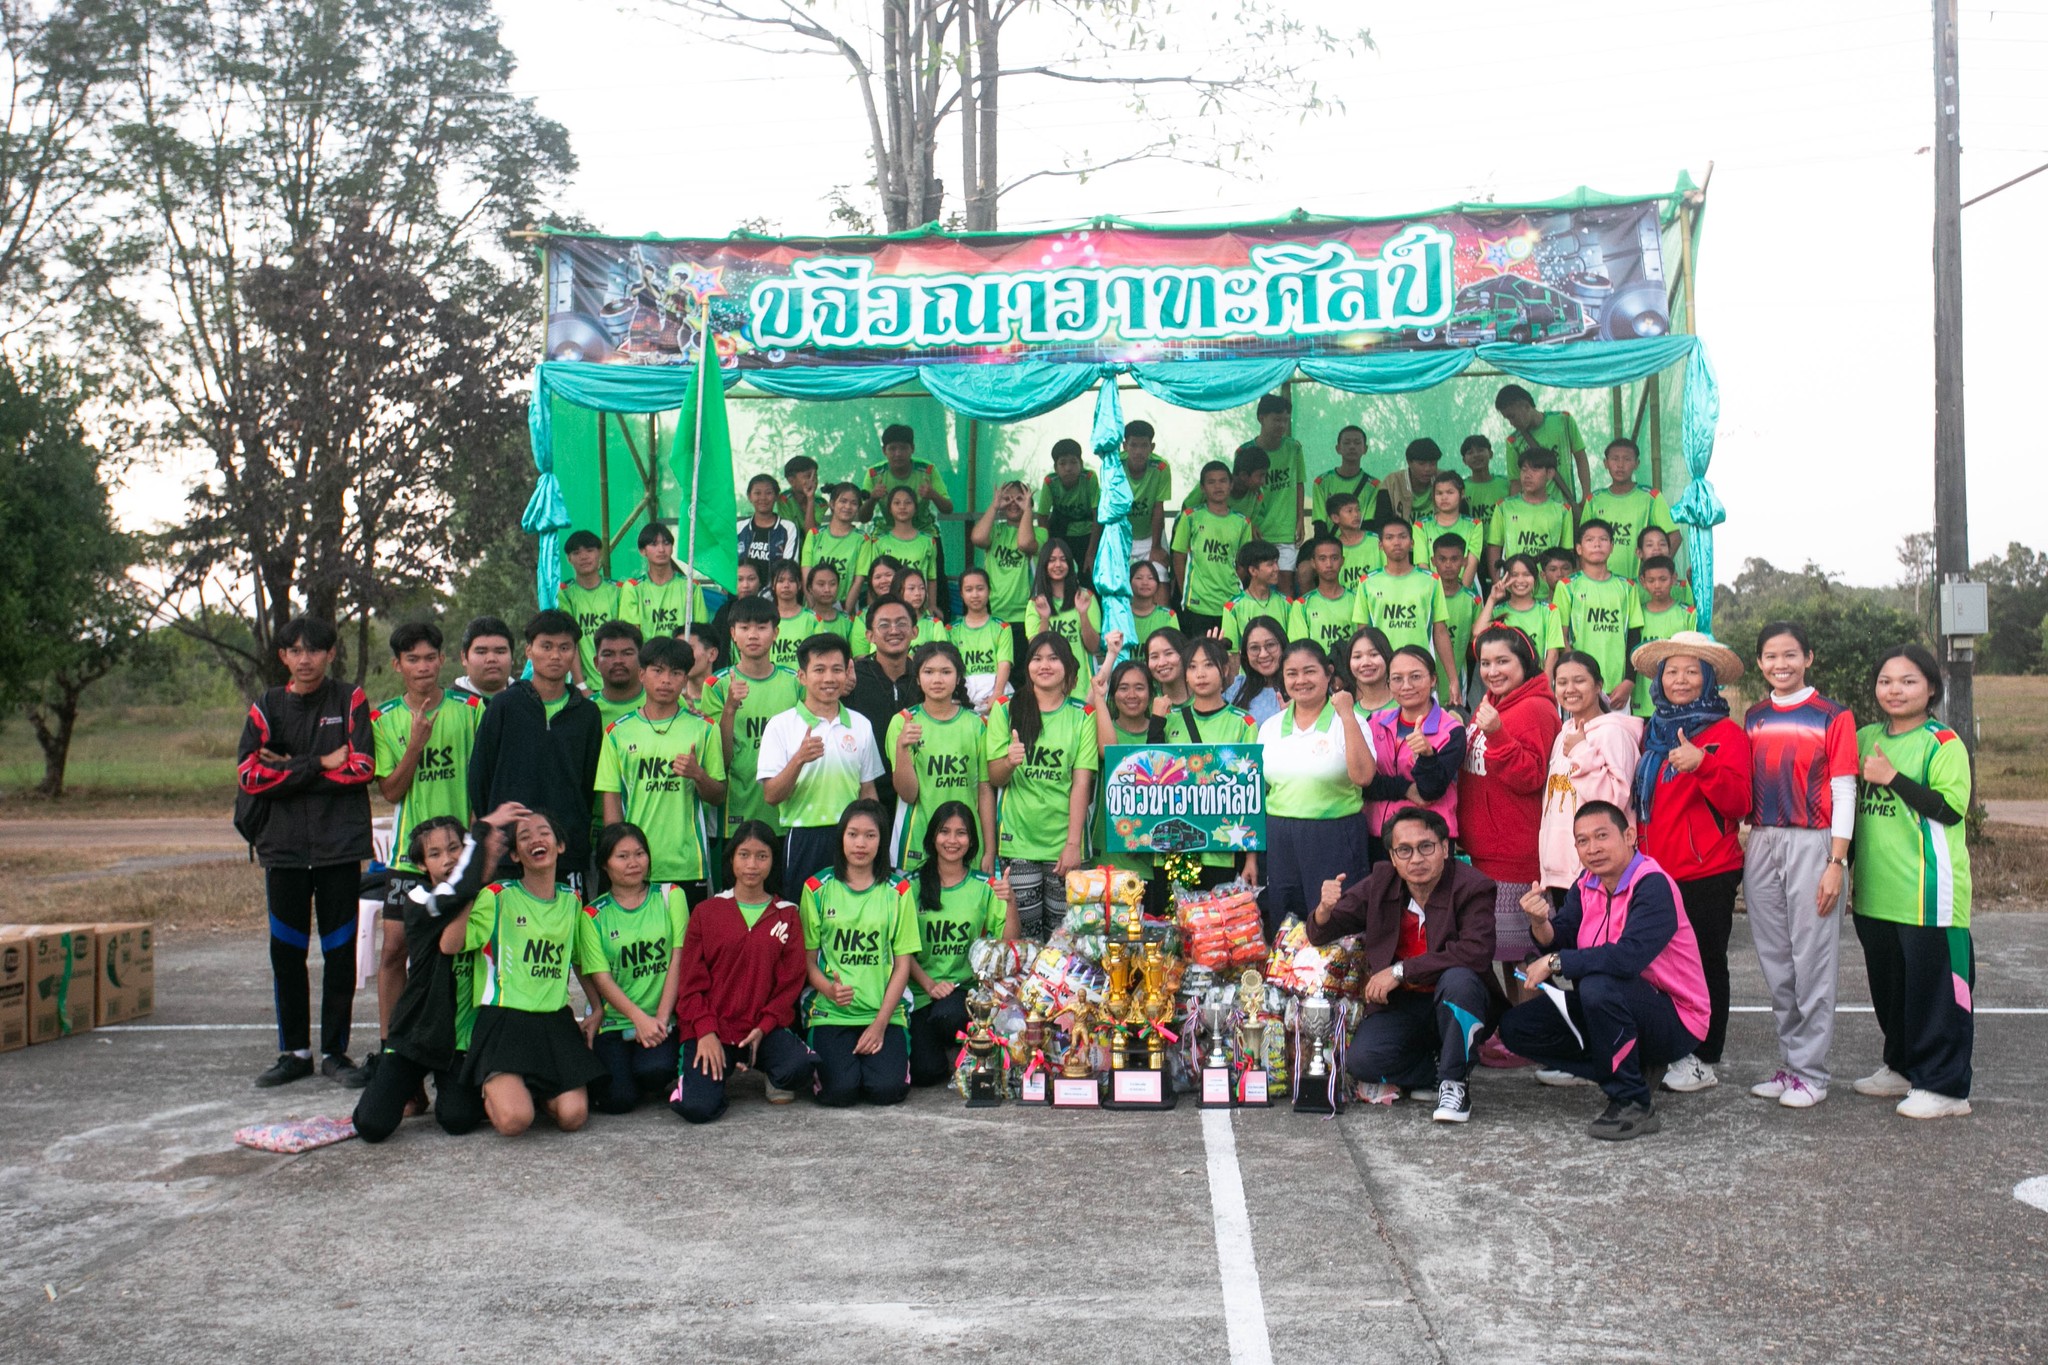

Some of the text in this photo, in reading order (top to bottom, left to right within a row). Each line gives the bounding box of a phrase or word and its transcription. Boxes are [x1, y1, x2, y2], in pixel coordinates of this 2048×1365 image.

[1518, 531, 1548, 547] NKS
[994, 545, 1023, 560] NKS
[1203, 538, 1230, 556] NKS
[652, 609, 678, 623] NKS
[1383, 604, 1417, 620] NKS
[1587, 607, 1619, 623] NKS
[1389, 620, 1417, 629] GAMES
[1593, 624, 1619, 633] GAMES
[1321, 625, 1351, 639] NKS
[776, 655, 797, 663] GAME
[965, 651, 993, 664] NKS
[970, 664, 995, 673] GAMES
[927, 754, 969, 777] NKS
[418, 768, 455, 782] GAMES
[1024, 767, 1062, 781] GAMES
[645, 781, 680, 792] GAMES
[936, 776, 968, 788] GAMES
[1859, 801, 1896, 817] GAMES
[926, 920, 971, 943] NKS
[833, 928, 880, 951] NKS
[523, 939, 565, 965] NKS
[621, 937, 667, 968] NKS
[932, 944, 968, 956] GAMES
[840, 954, 879, 966] GAMES
[531, 964, 562, 979] GAMES
[632, 960, 668, 979] GAMES
